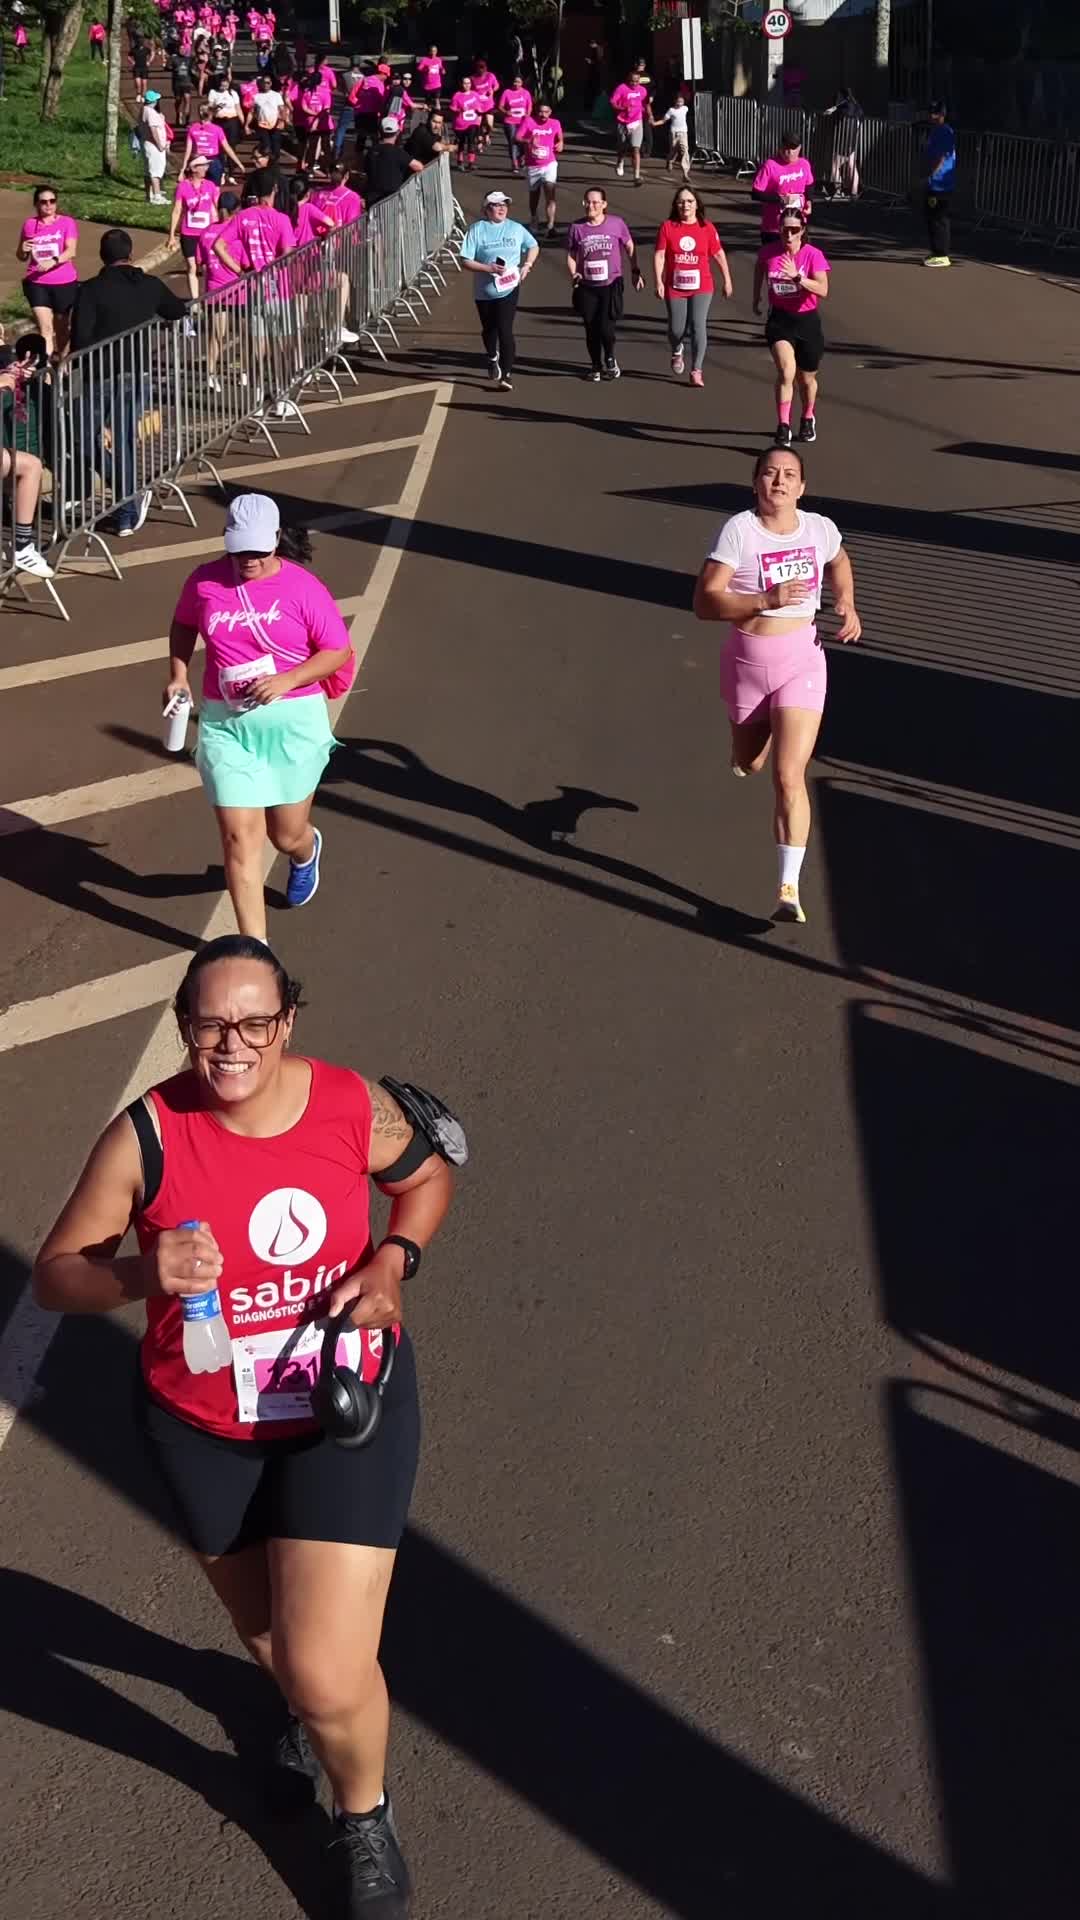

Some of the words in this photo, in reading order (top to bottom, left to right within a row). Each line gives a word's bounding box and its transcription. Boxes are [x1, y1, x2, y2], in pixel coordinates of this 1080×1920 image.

[767, 14, 786, 26] 40
[777, 561, 809, 577] 1735
[233, 1302, 306, 1325] DIAGNÓSTICO
